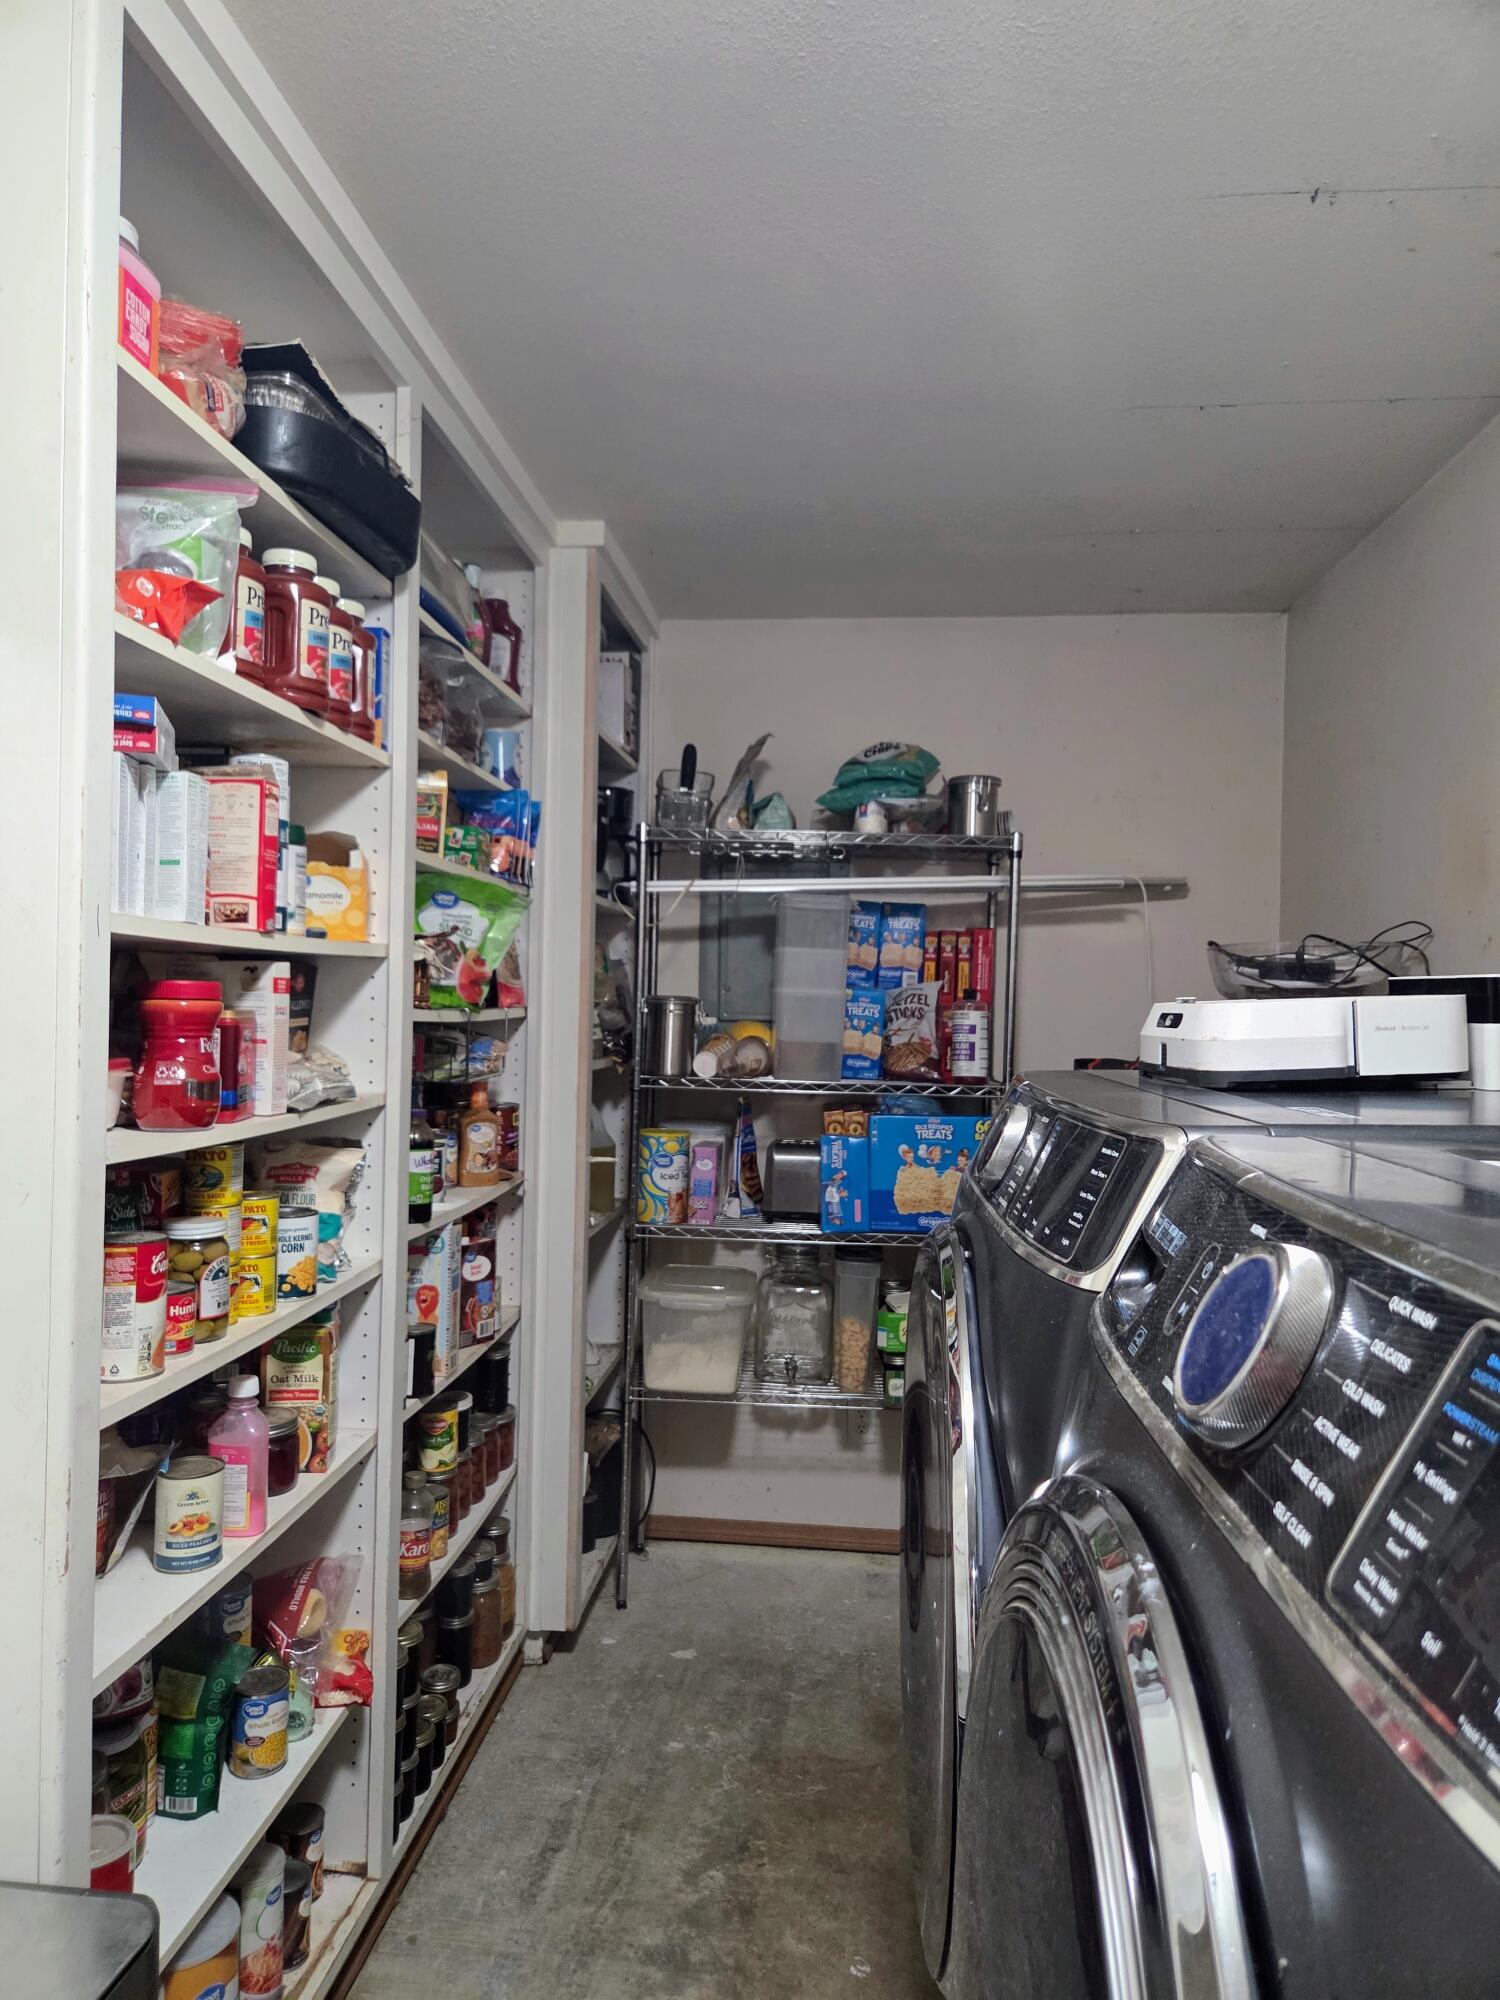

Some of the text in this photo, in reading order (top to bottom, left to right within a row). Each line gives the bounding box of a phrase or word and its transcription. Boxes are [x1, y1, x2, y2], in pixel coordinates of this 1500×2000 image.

[126, 288, 151, 325] COTTON
[126, 303, 148, 337] CANDY
[438, 922, 474, 937] Stvia
[888, 921, 919, 930] TREATS
[848, 1007, 880, 1018] TREATS
[916, 1129, 952, 1140] TREATS
[928, 1122, 953, 1131] KRISPIES
[830, 1141, 840, 1169] TREATS
[660, 1172, 680, 1180] Iced
[291, 1192, 316, 1206] FLOUR
[281, 1242, 305, 1254] CORN
[1389, 1295, 1438, 1331] QUICK WASH
[275, 1338, 318, 1355] Pacific
[1369, 1338, 1412, 1374] DELICATES
[270, 1374, 319, 1384] Oat Milk
[1341, 1378, 1387, 1418] COLD WASH
[1336, 1430, 1361, 1461] WEAR
[1291, 1458, 1314, 1488] RINSE
[1314, 1481, 1335, 1509] SPIN
[1412, 1460, 1459, 1504] My Settings
[1273, 1500, 1312, 1550] SELF CLEAN
[1386, 1508, 1407, 1534] More
[1404, 1521, 1430, 1551] Water
[188, 1537, 213, 1548] PEACHES
[400, 1541, 424, 1557] Karo
[1358, 1557, 1400, 1606] Delay Wash
[1084, 1611, 1114, 1697] SYSTEM
[1420, 1629, 1443, 1659] Soil
[245, 1704, 264, 1714] Great
[248, 1720, 271, 1730] Whole
